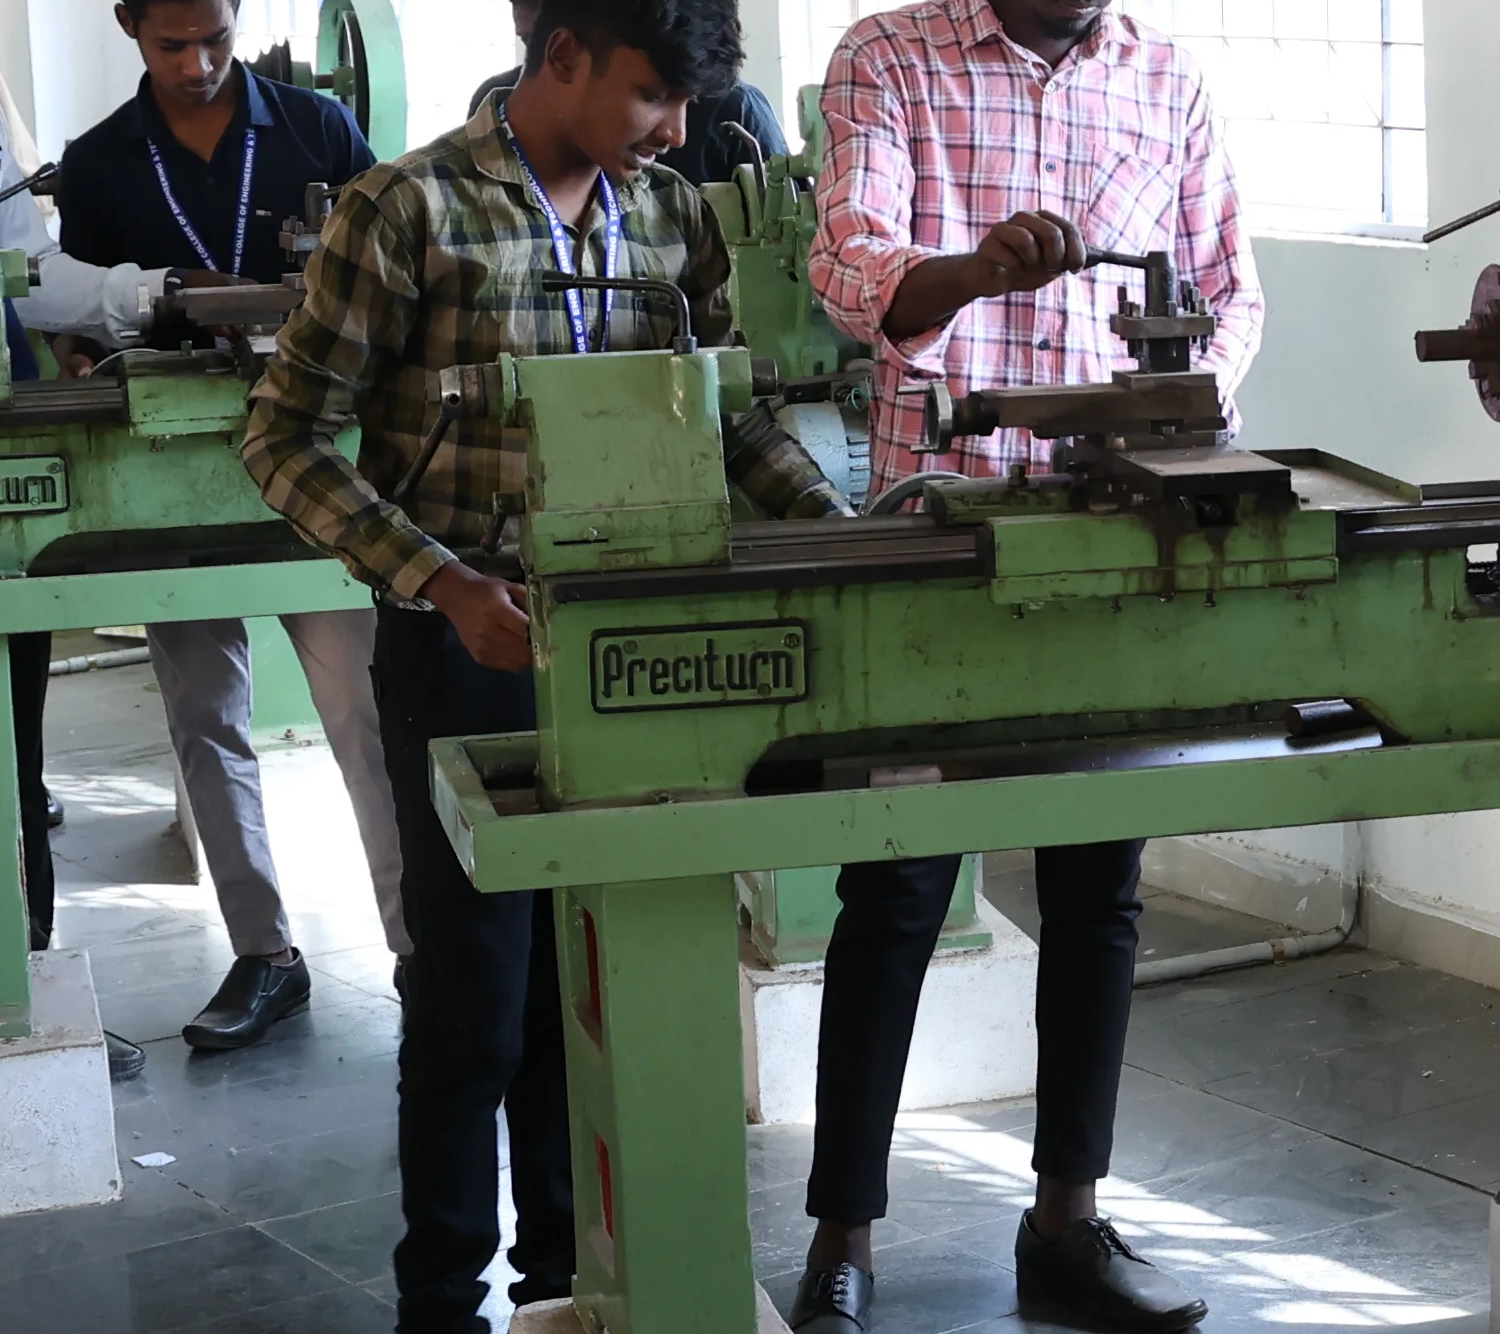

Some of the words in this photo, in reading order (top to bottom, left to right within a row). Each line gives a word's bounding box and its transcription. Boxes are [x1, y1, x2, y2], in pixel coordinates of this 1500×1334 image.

[239, 204, 247, 216] OF
[183, 224, 208, 259] COLLEGE
[235, 216, 246, 255] COLLEGE
[573, 318, 583, 334] OF
[601, 638, 793, 698] Preciturn
